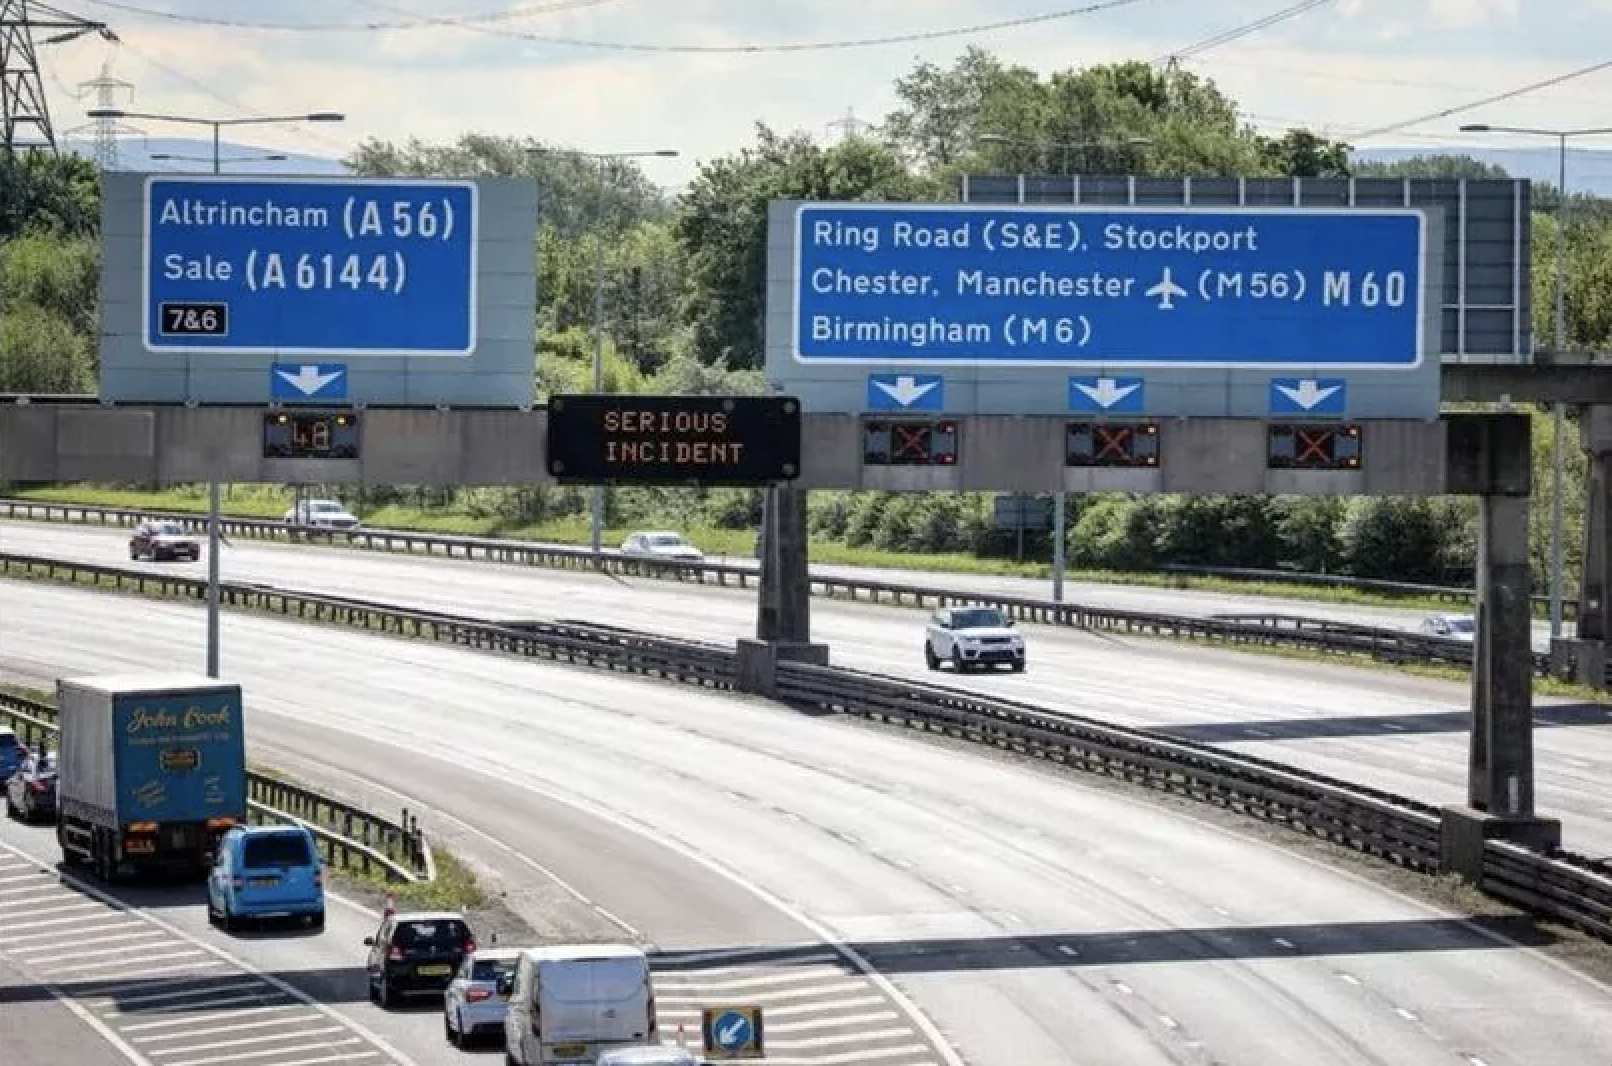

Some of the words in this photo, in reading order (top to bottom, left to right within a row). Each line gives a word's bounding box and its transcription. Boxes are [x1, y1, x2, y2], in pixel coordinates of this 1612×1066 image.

[160, 199, 328, 227] Altrincham
[814, 220, 879, 251] Ring
[894, 222, 970, 247] Road
[1104, 224, 1258, 253] Stockport
[164, 254, 233, 280] Sale
[957, 270, 1135, 297] Manchester
[169, 309, 218, 331] 7&6
[812, 315, 991, 347] Birmingham
[603, 411, 727, 432] SERIOUS
[605, 440, 744, 463] INCIDENT
